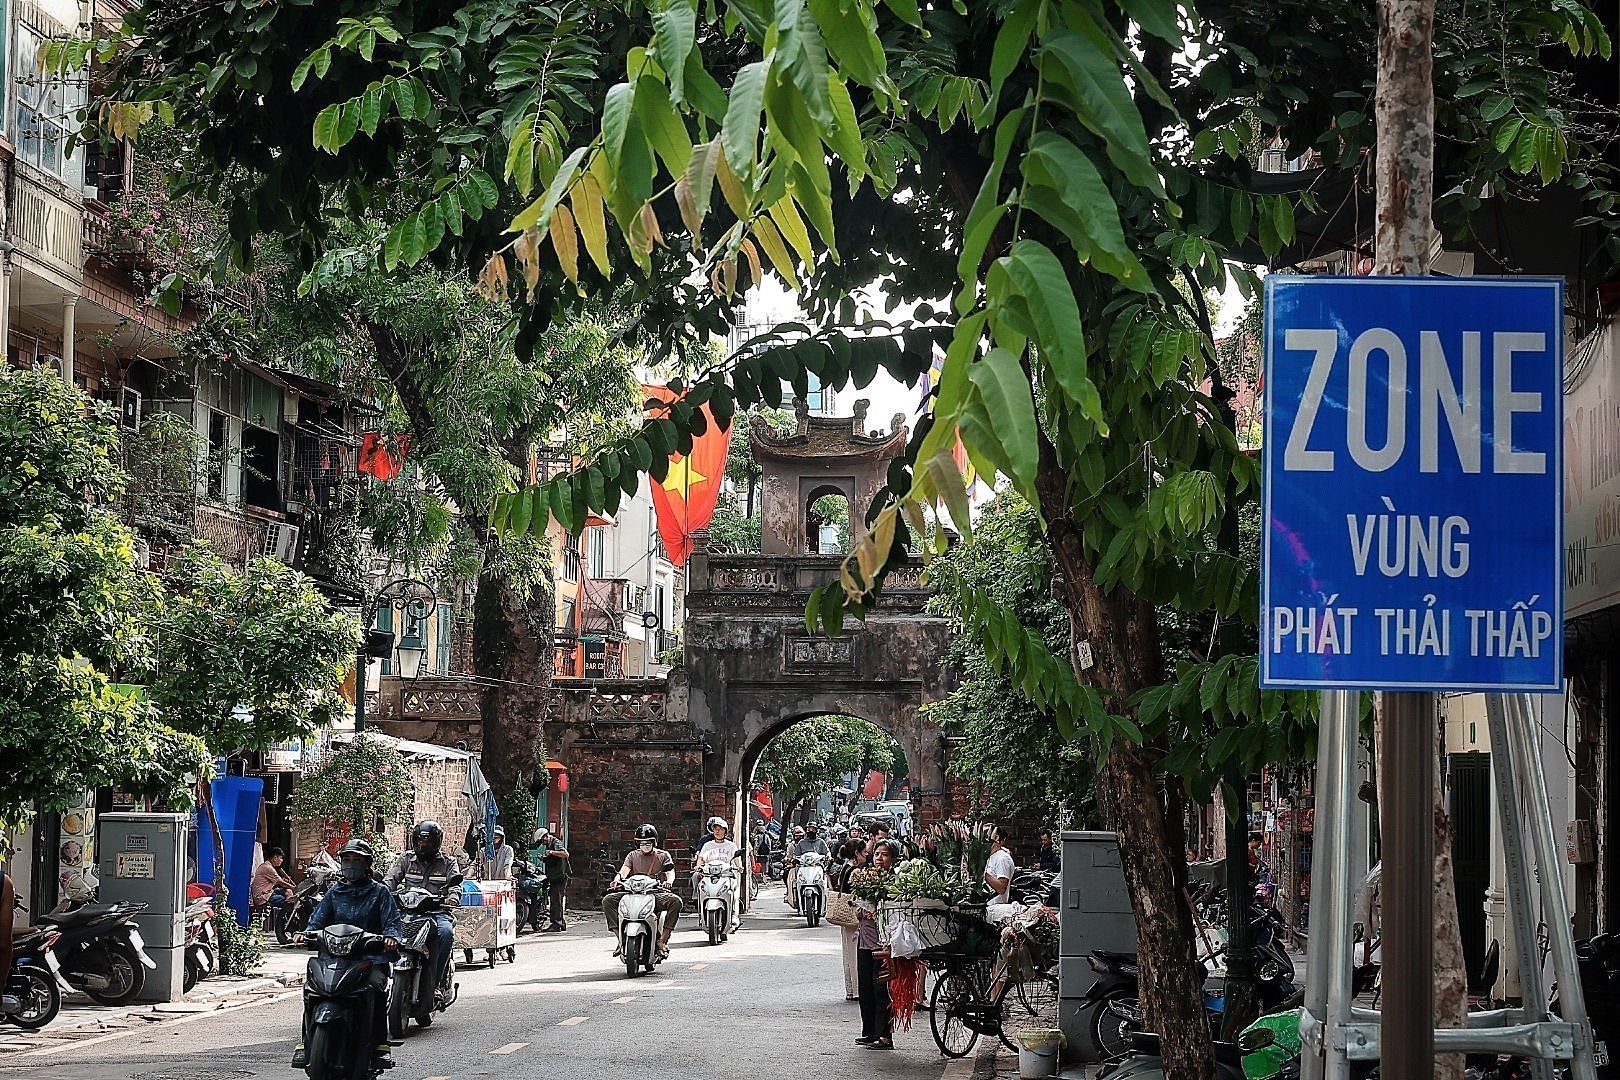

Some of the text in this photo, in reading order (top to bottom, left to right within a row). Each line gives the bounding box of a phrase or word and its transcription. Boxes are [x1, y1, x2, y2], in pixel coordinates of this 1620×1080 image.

[1283, 327, 1546, 474] ZONE
[1346, 495, 1470, 578] VÙNG
[1273, 593, 1552, 658] PHÁT THẢI THẤP
